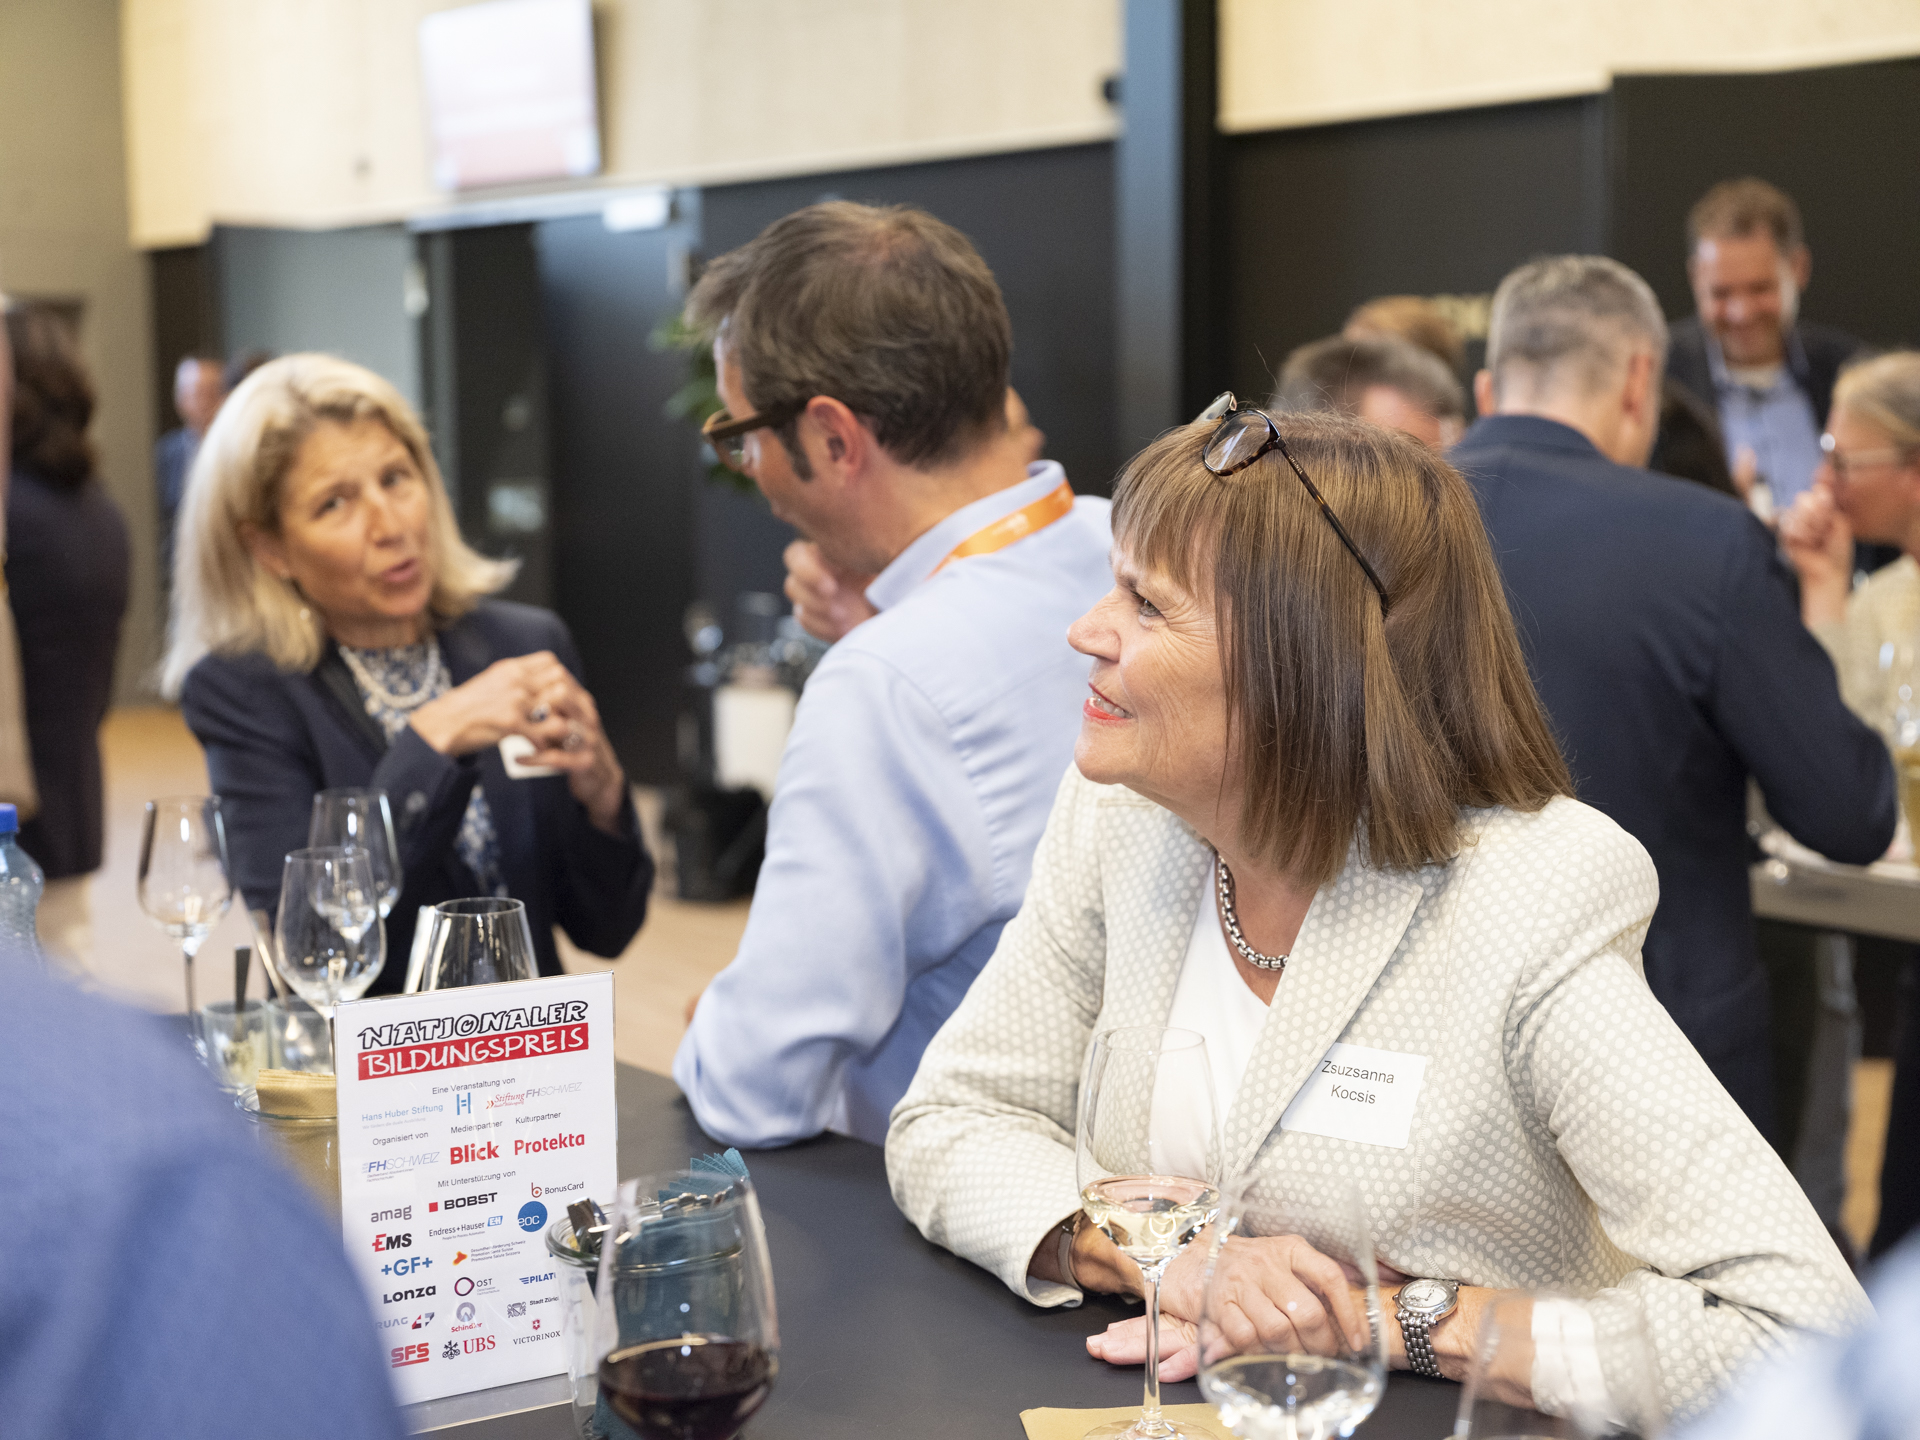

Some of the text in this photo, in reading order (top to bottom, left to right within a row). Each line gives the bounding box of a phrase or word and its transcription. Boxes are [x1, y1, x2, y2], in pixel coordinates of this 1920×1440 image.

[357, 1000, 588, 1050] NATIONALER
[362, 1027, 584, 1076] BILDUNGSPREIS
[1321, 1060, 1395, 1084] Zsuzsanna
[432, 1077, 516, 1095] Eine Veranstaltung von
[1330, 1084, 1376, 1104] Kocsis
[494, 1092, 525, 1103] Stiftung
[361, 1104, 444, 1122] Hans Huber Stiftung
[515, 1112, 561, 1124] Kulturpartner
[450, 1121, 503, 1134] Medienpartner
[372, 1131, 429, 1146] Organisiert von
[514, 1133, 585, 1155] Protekta
[450, 1141, 500, 1165] Blick
[438, 1180, 449, 1188] Mit
[451, 1172, 501, 1186] Unterstützung
[544, 1181, 584, 1194] BonusCard
[444, 1192, 498, 1210] BOBST
[371, 1205, 412, 1223] amag
[372, 1233, 412, 1252] EMS
[476, 1278, 493, 1288] OST
[383, 1285, 436, 1304] Lonza
[451, 1322, 482, 1333] Schindr
[463, 1335, 496, 1354] UBS
[513, 1330, 561, 1345] VICTORINOX
[391, 1342, 430, 1363] SFS
